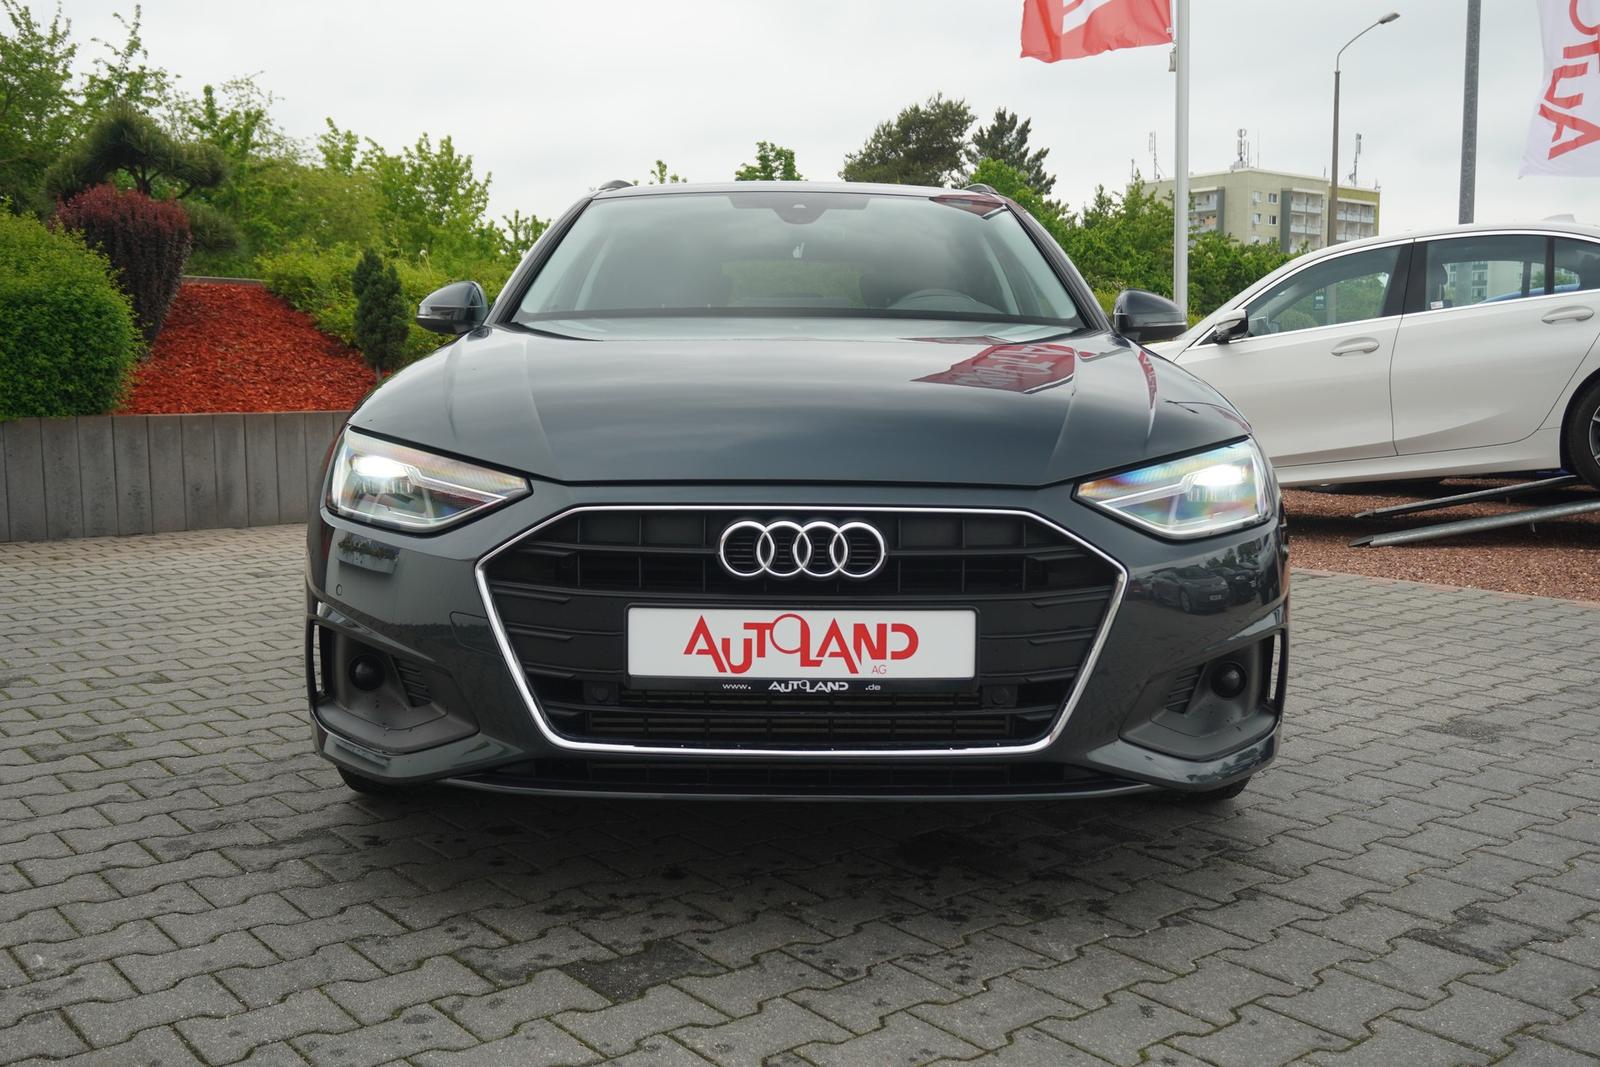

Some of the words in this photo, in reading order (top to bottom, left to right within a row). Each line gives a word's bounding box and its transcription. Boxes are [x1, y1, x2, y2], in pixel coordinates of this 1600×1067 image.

[684, 613, 919, 674] AUTOLAND
[871, 664, 887, 675] AG
[722, 683, 752, 691] www.
[768, 680, 849, 693] AUTOLAND
[865, 683, 881, 691] .de
